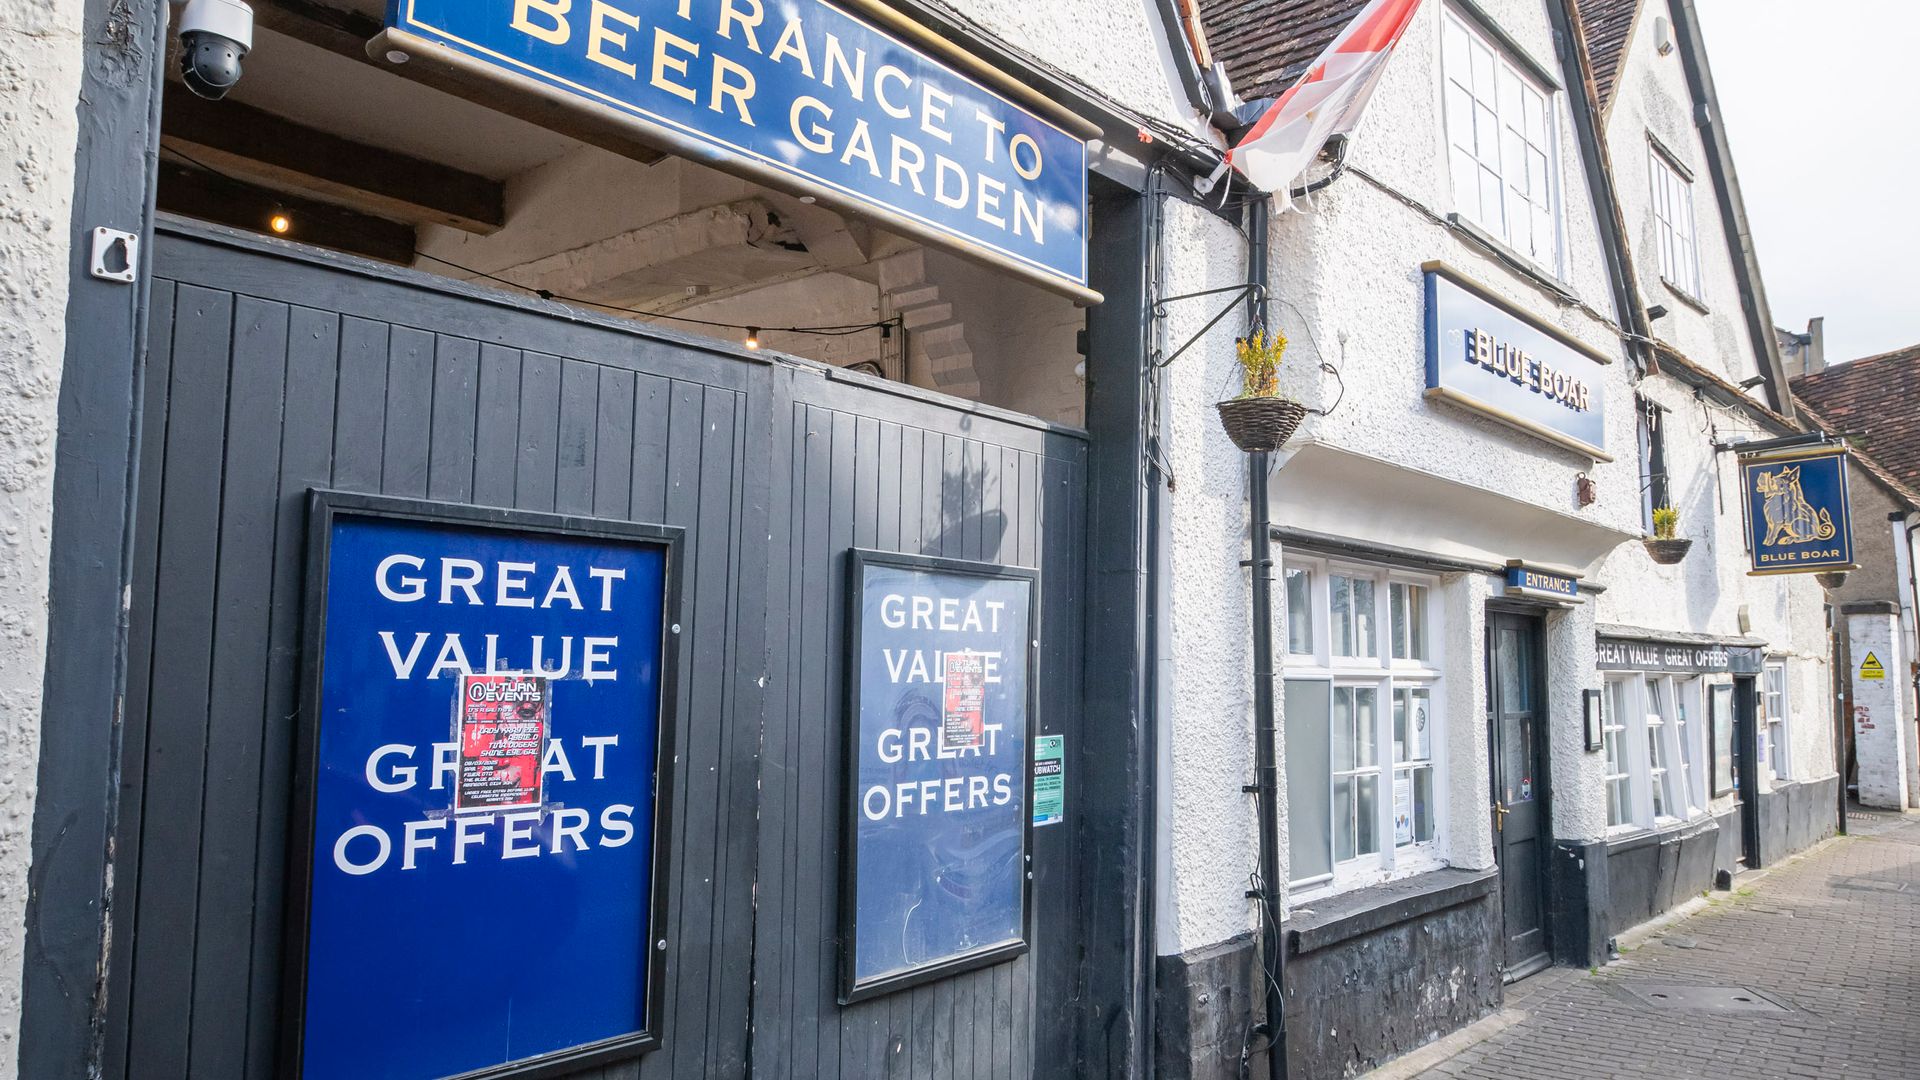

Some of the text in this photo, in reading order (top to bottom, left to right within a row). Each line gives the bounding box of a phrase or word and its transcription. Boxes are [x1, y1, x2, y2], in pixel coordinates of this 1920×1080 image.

[509, 0, 1046, 246] BEER GARDEN
[975, 108, 1044, 182] TO
[1474, 327, 1590, 412] BLUE BOAR
[1760, 549, 1840, 562] BLUE BOAR
[375, 553, 626, 612] GREAT
[1526, 572, 1570, 593] ENTRANCE
[880, 594, 1005, 633] GREAT
[378, 631, 618, 681] VALUE
[883, 648, 1002, 683] VALE
[1628, 645, 1660, 665] VALUE
[1664, 647, 1693, 666] GREAT
[1695, 649, 1728, 667] OFFERS
[486, 682, 537, 692] U-TURN
[486, 692, 541, 701] EVENTS
[365, 734, 619, 793] GRAT
[480, 749, 505, 757] SHINE
[863, 773, 1012, 821] OFFERS
[333, 803, 635, 876] OFFERS
